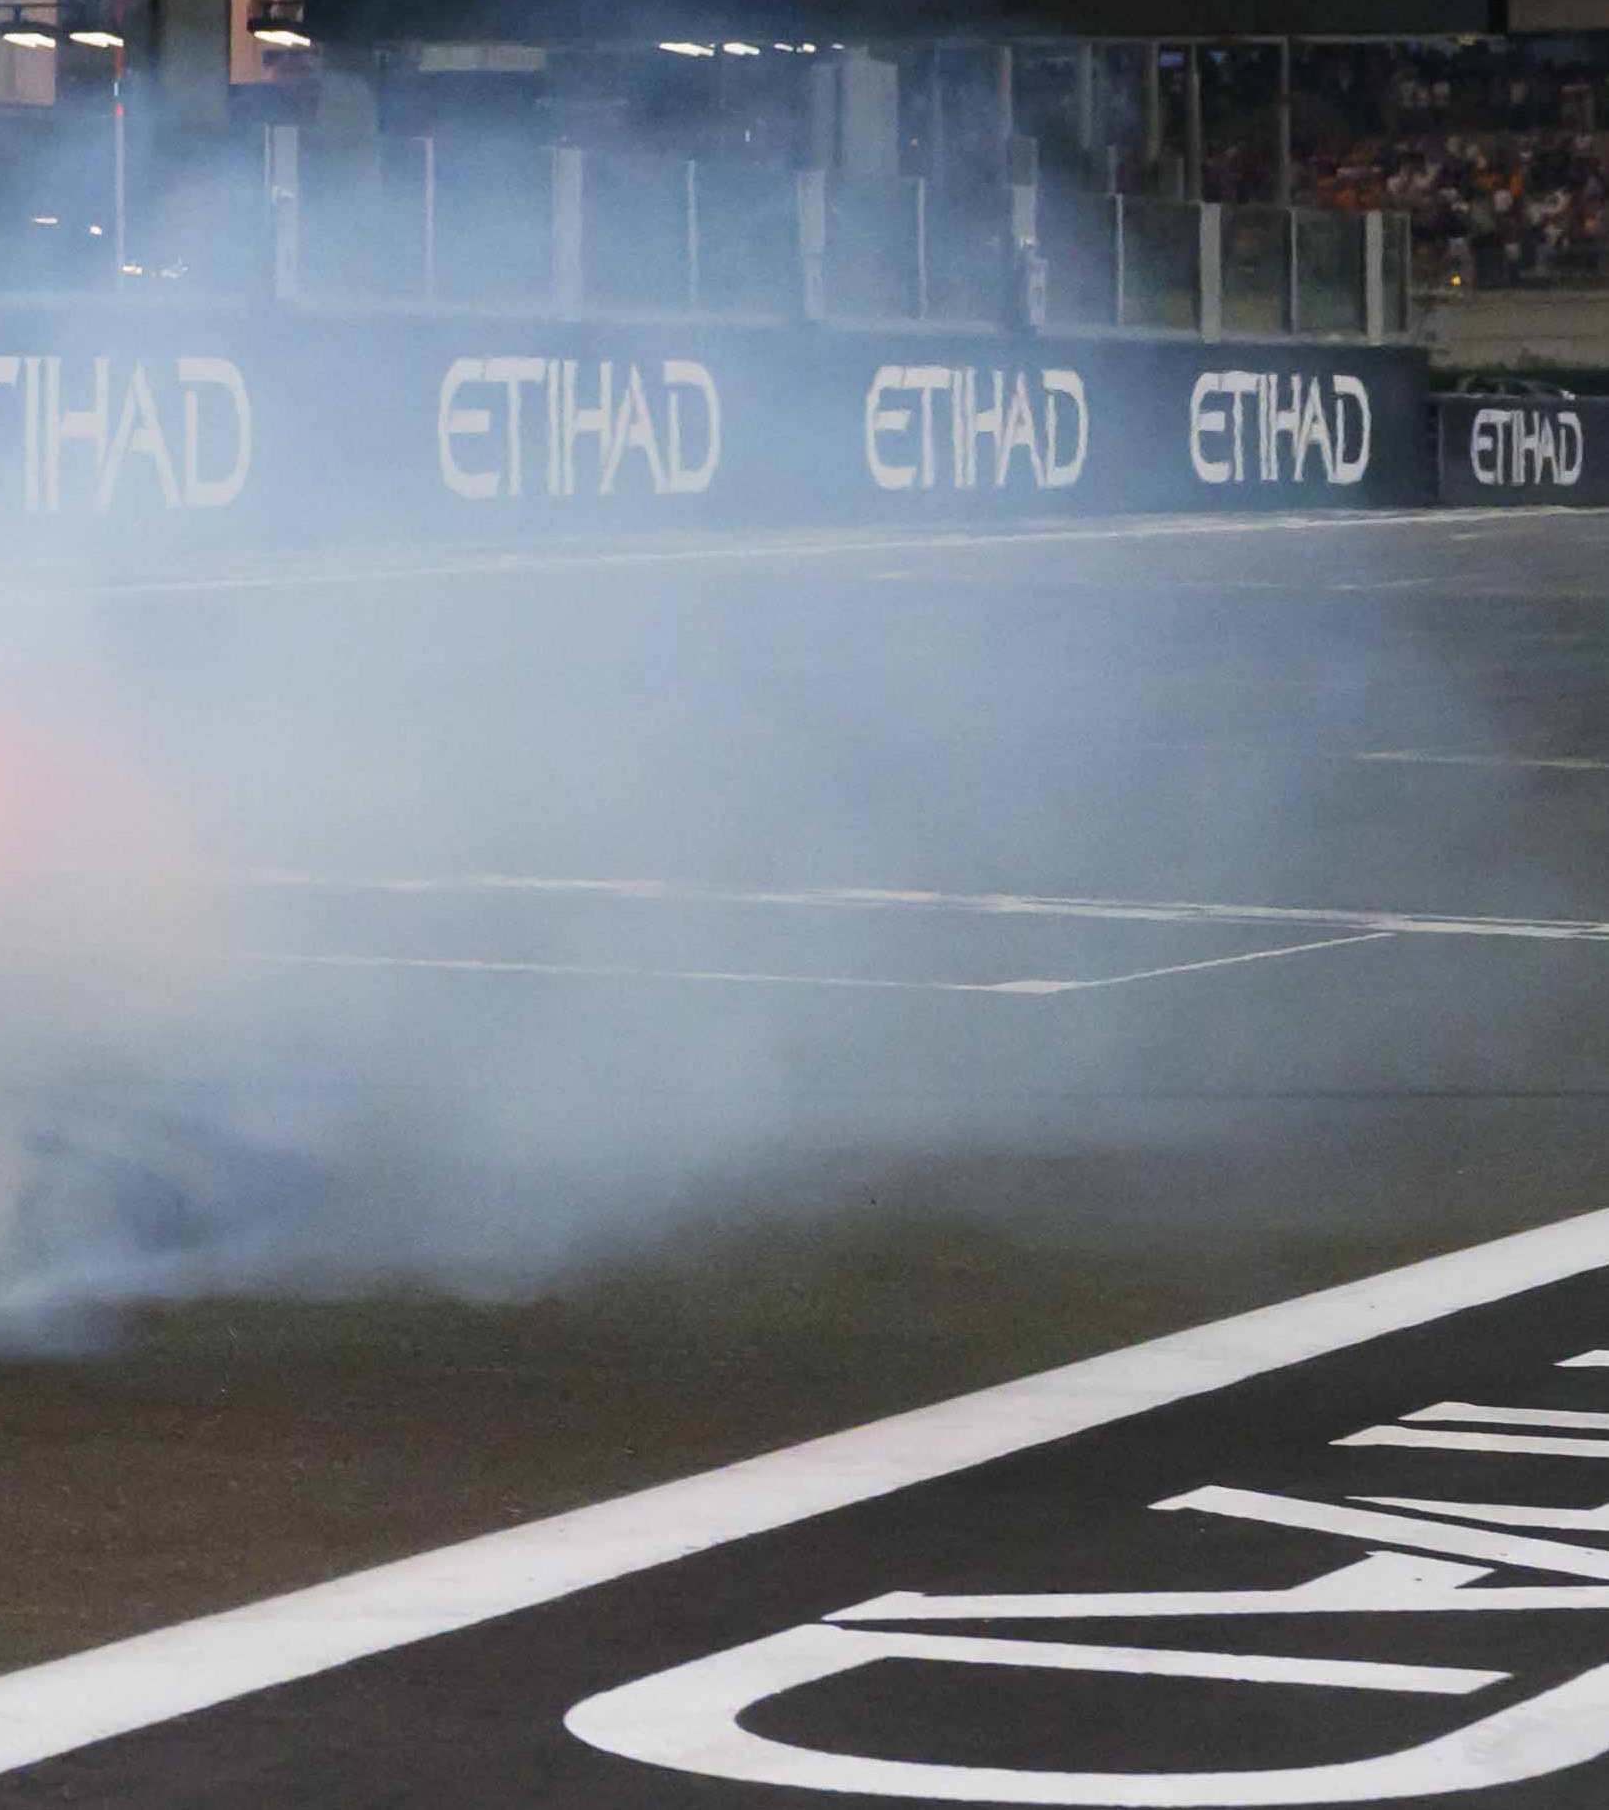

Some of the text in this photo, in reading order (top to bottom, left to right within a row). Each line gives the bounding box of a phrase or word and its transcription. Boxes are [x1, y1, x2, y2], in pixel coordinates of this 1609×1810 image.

[436, 357, 721, 499] ETIHAD
[863, 364, 1090, 492] ETIHAD
[1189, 370, 1372, 487] ETIHAD
[1469, 406, 1584, 487] ETIHAD
